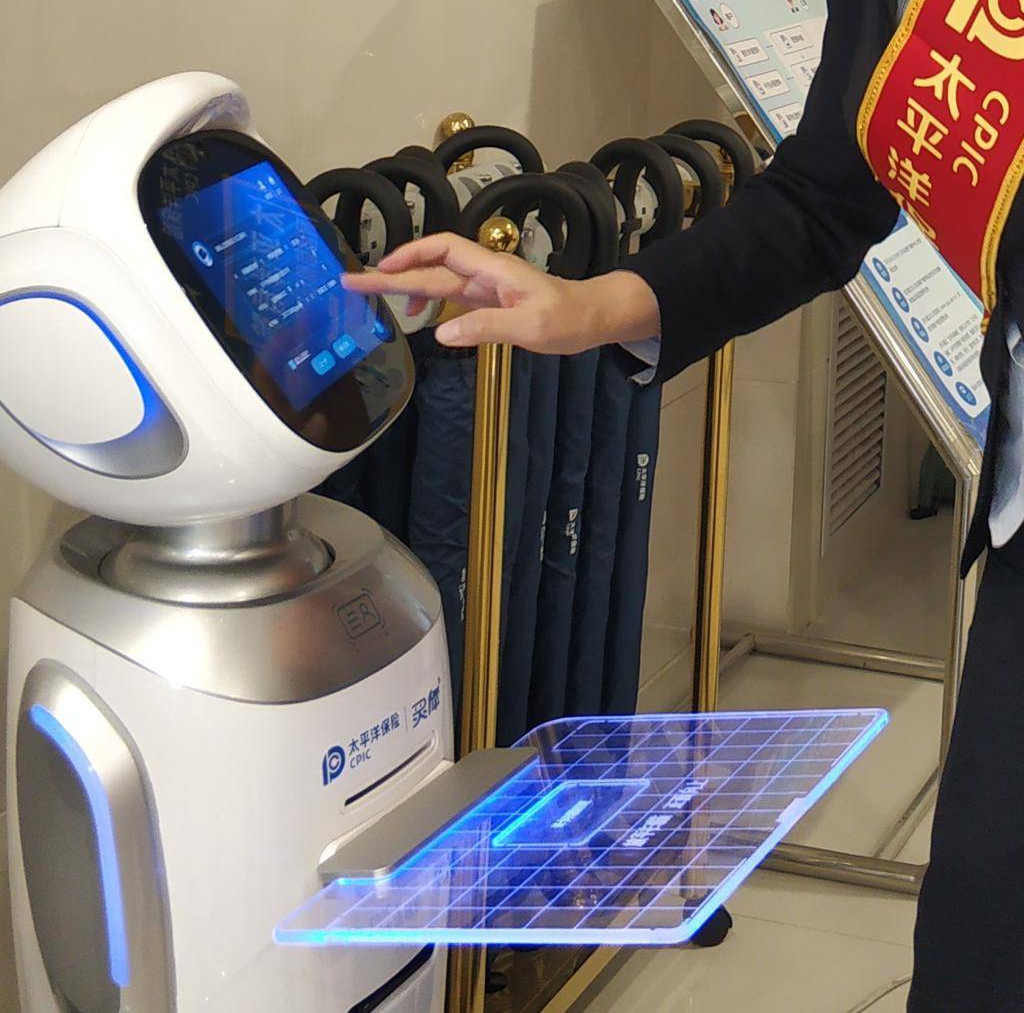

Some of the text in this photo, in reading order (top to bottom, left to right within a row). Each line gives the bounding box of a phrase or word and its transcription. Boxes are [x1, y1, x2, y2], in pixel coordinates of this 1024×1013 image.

[952, 89, 1010, 187] CPIC
[348, 712, 401, 757] 太平洋保险
[350, 748, 372, 769] CPIC
